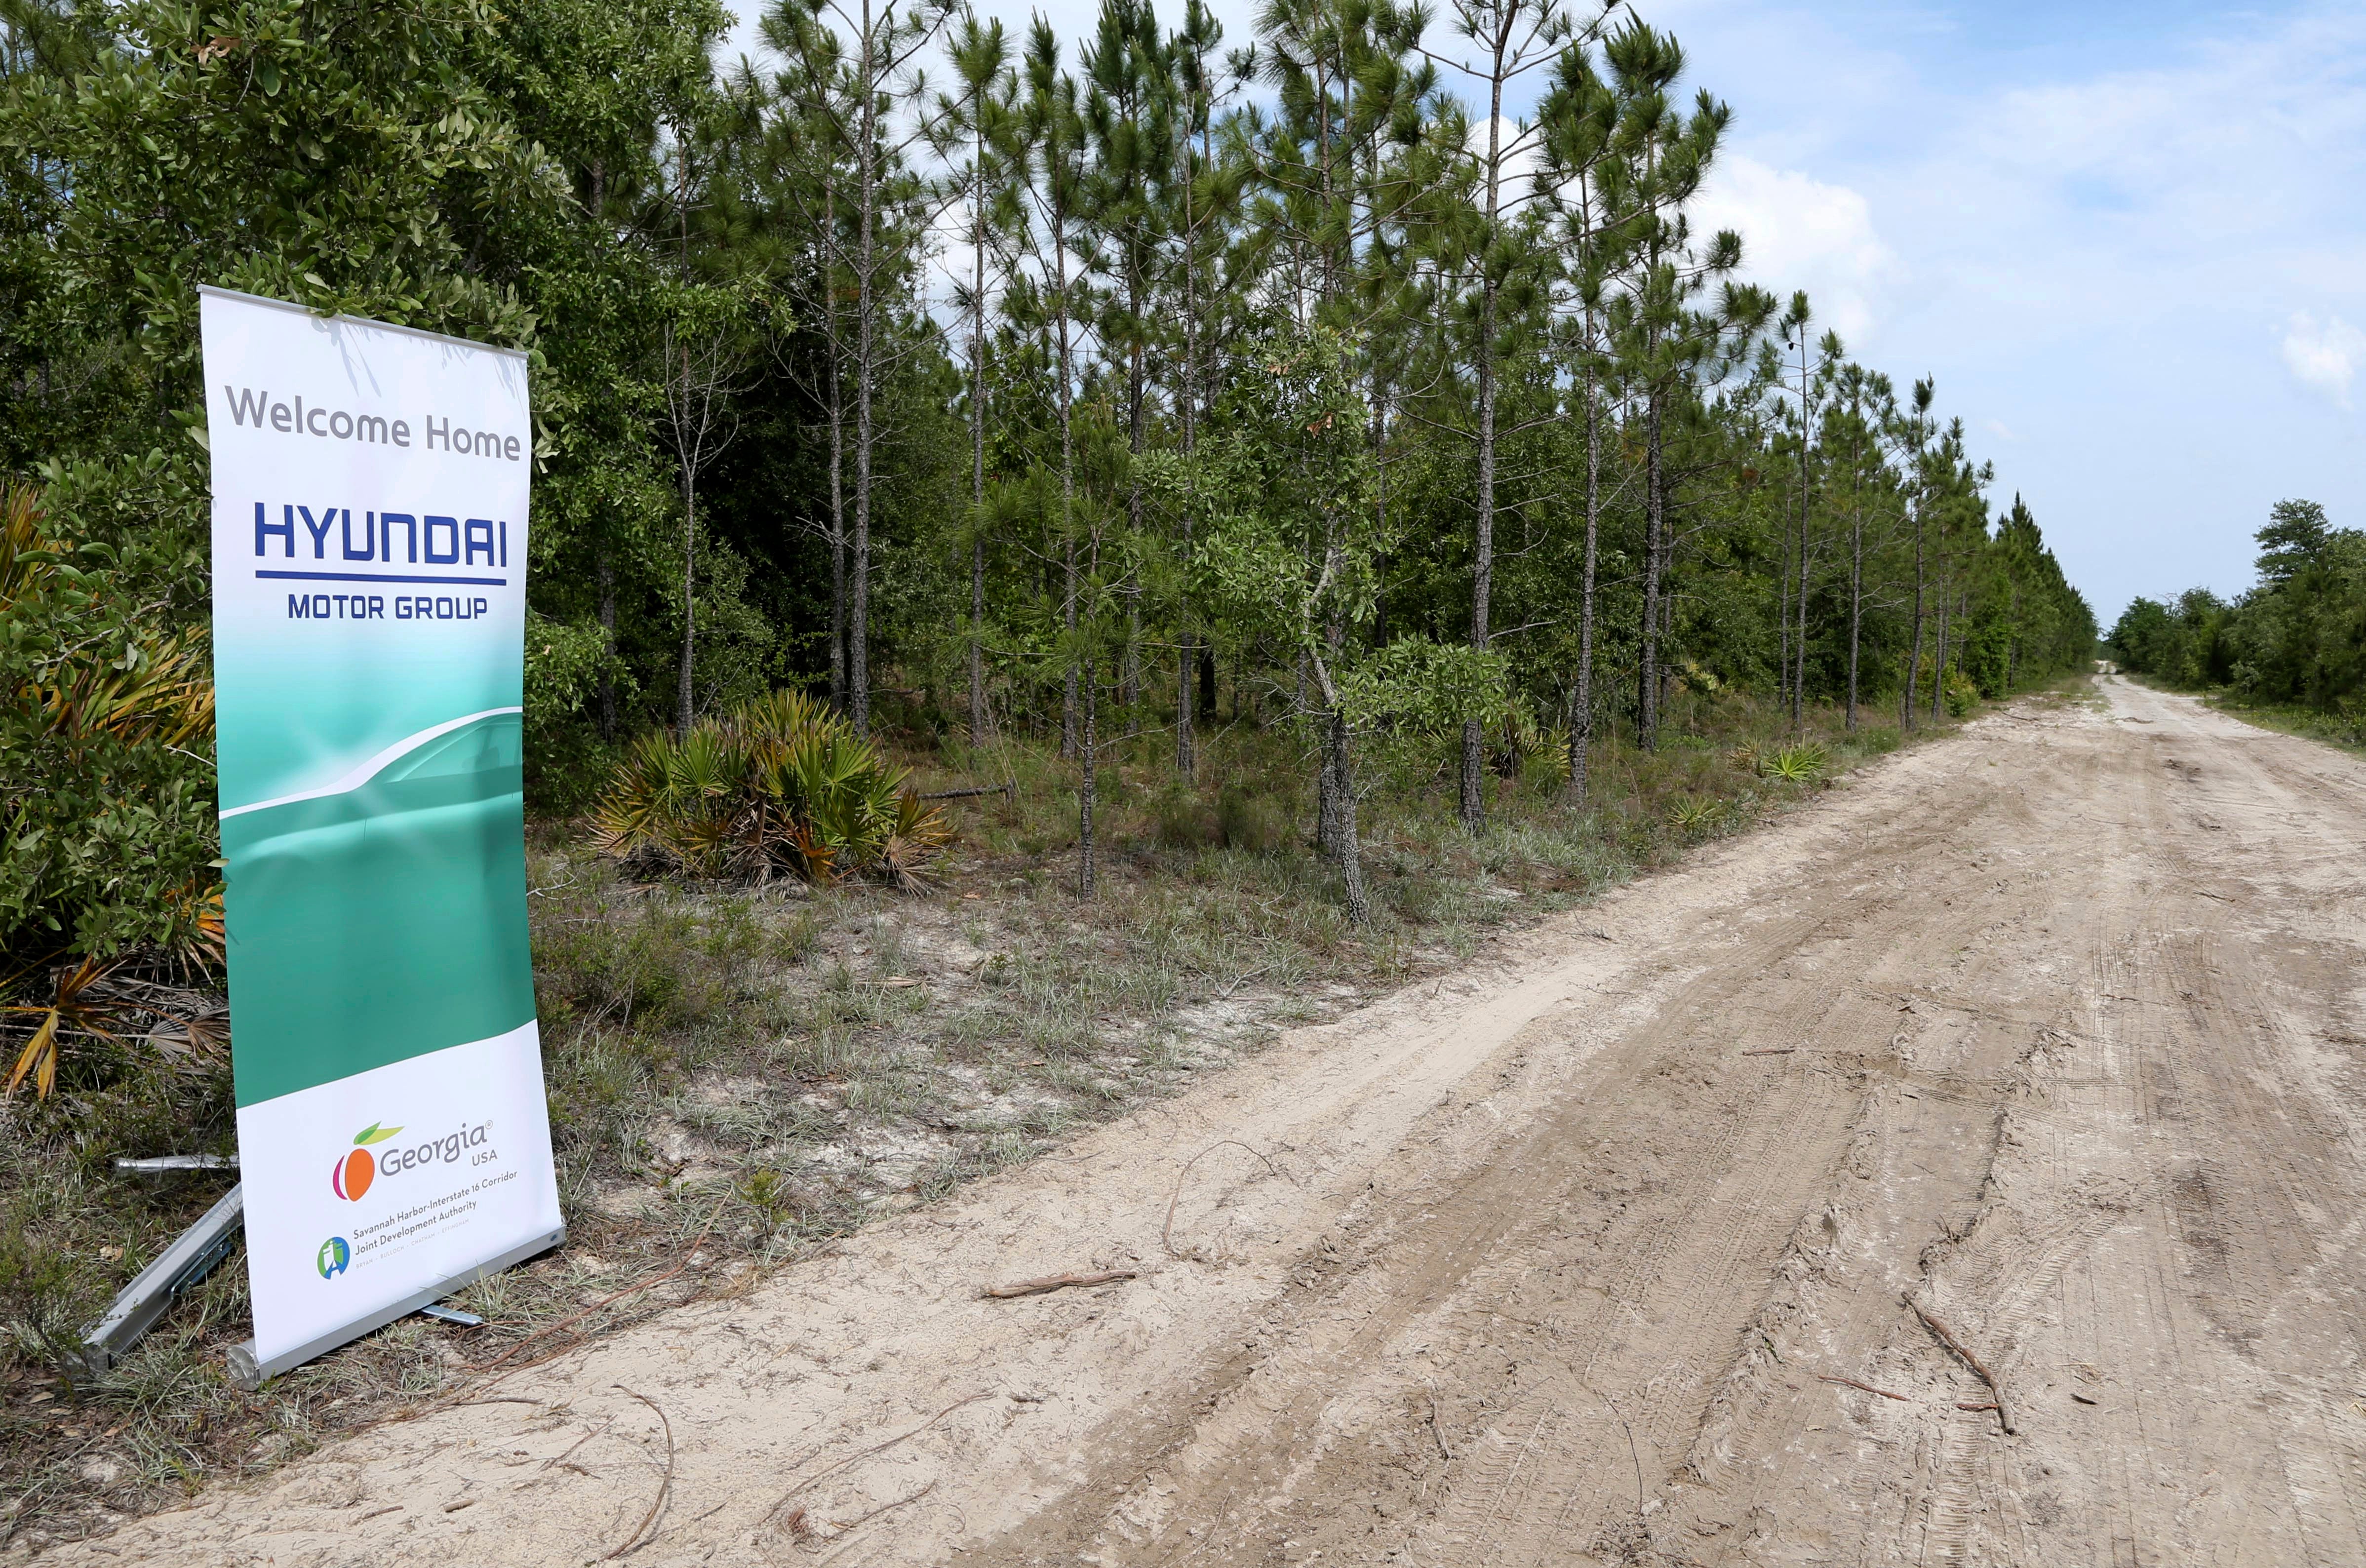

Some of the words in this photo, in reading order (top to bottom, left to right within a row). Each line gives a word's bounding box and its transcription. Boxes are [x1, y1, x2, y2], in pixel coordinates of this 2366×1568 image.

[224, 385, 410, 447] Welcome
[426, 415, 520, 461] Home
[254, 502, 507, 567] HYUNDAI
[288, 593, 385, 620] MOTOR
[395, 596, 488, 620] GROUP
[472, 1149, 498, 1166] USA
[354, 1215, 395, 1240] Savannah
[397, 1188, 470, 1222] Harbor-Interstate
[472, 1182, 480, 1193] 16
[482, 1171, 518, 1188] Corridor
[355, 1239, 378, 1255] Joint
[380, 1215, 437, 1245] Development
[439, 1200, 476, 1221] Authority
[411, 1232, 435, 1246] CHATHAM
